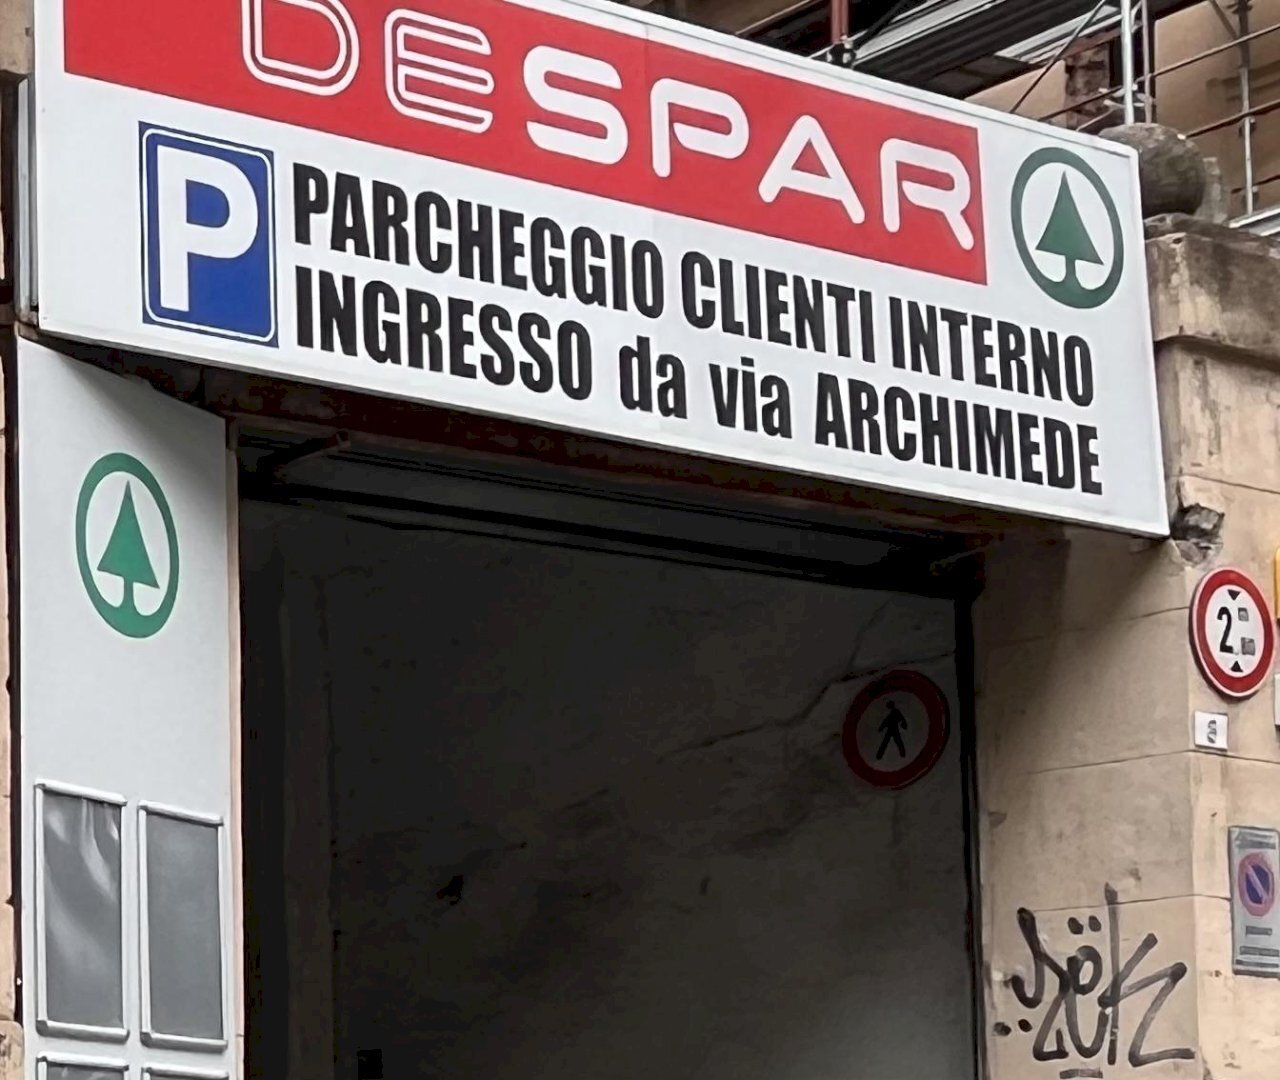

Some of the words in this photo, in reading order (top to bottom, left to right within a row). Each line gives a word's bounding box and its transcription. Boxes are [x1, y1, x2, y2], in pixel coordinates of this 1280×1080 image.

[157, 144, 259, 313] P
[241, 0, 975, 250] DESPAR
[293, 162, 664, 319] PARCHEGGIO
[681, 250, 876, 363] CLIENTI
[889, 296, 1095, 407] INTERNO
[295, 265, 593, 401] INGRESSO
[618, 335, 688, 420] da
[708, 355, 792, 440] via
[814, 372, 1103, 496] ARCHIMEDE
